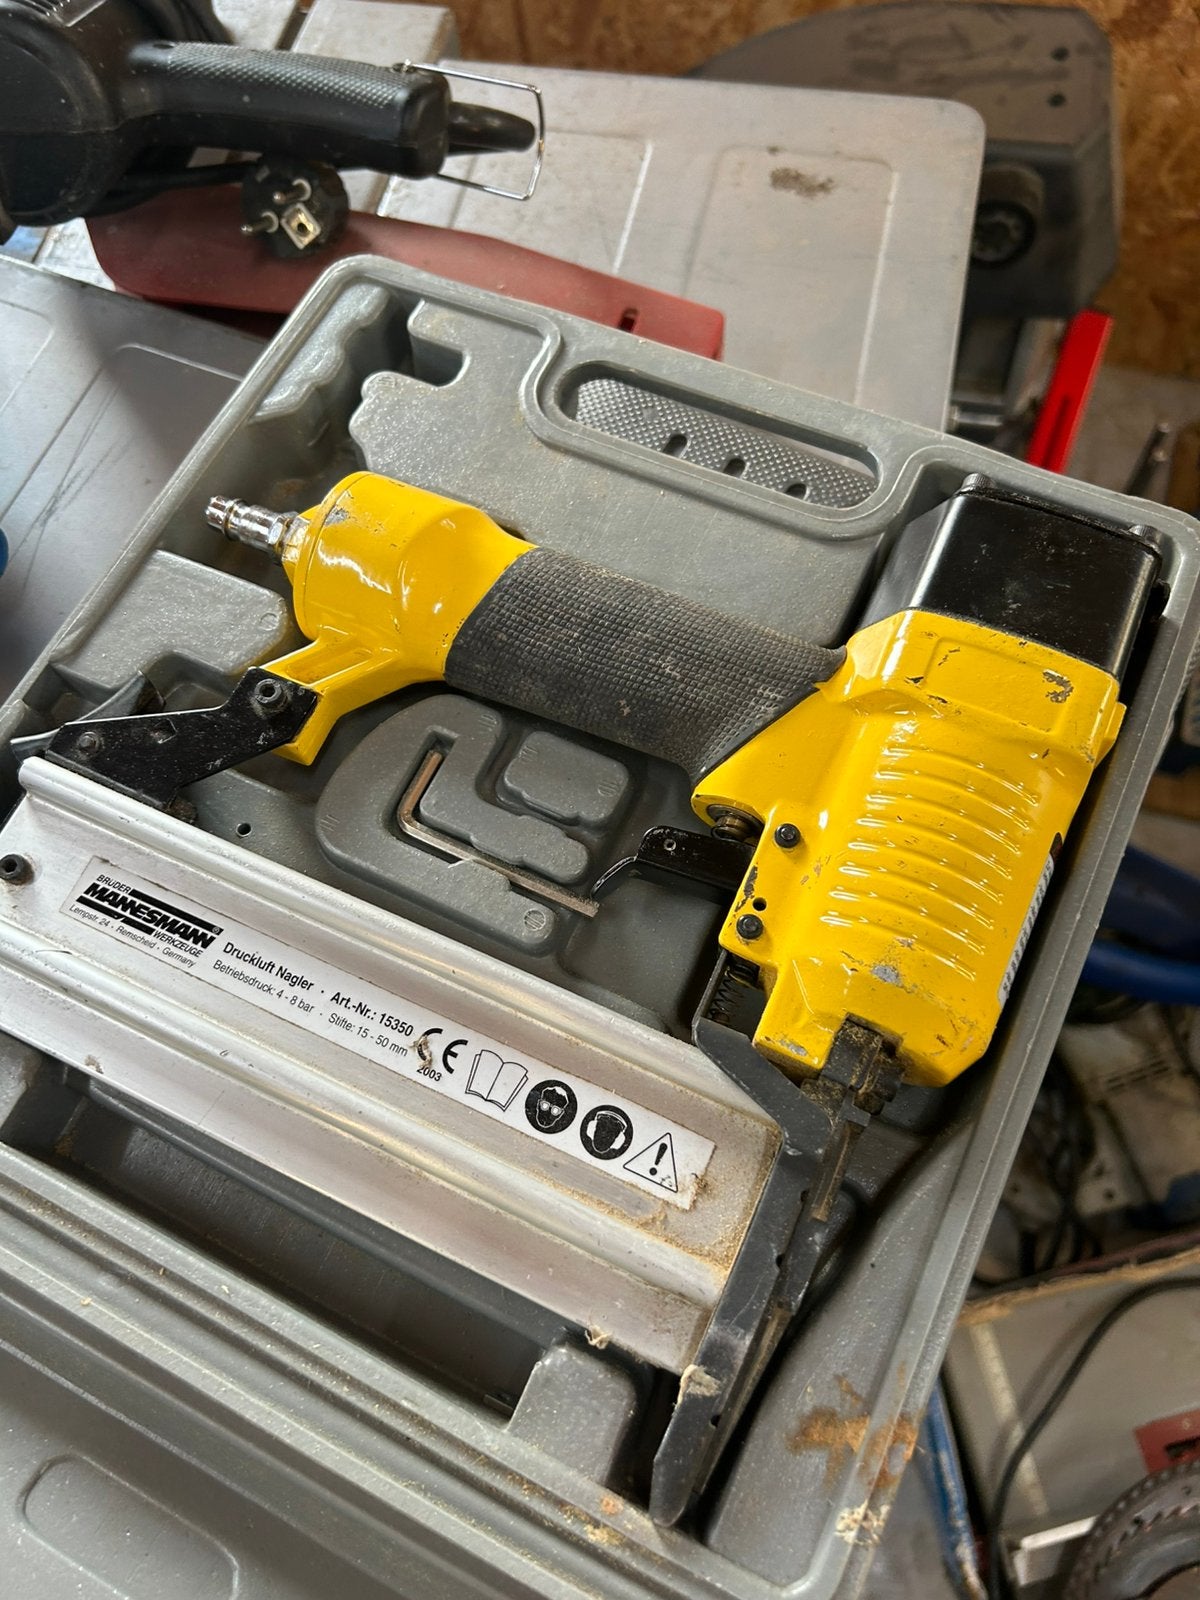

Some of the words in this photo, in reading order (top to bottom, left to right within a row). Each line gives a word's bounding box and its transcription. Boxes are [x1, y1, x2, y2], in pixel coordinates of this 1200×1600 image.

[69, 904, 99, 923] Lempstr.
[98, 917, 110, 927] 24
[116, 925, 157, 949] Remscheid
[162, 946, 196, 968] Germany
[83, 882, 216, 949] MANNESMANN
[153, 930, 204, 958] WERKZEUGE
[213, 959, 276, 995] Betriebsdruck:
[276, 989, 284, 999] 4
[289, 995, 298, 1006] 8
[297, 998, 315, 1013] bar
[328, 1012, 356, 1033] Stifte:
[357, 1026, 369, 1039] 15
[375, 1034, 390, 1048] 50
[389, 1043, 408, 1057] mm
[223, 942, 276, 974] Druckluft
[275, 965, 314, 991] Nagler
[330, 991, 377, 1021] Art.-Nr.:
[378, 1013, 414, 1037] 15350
[416, 1027, 469, 1074] CE
[416, 1066, 442, 1082] 2003
